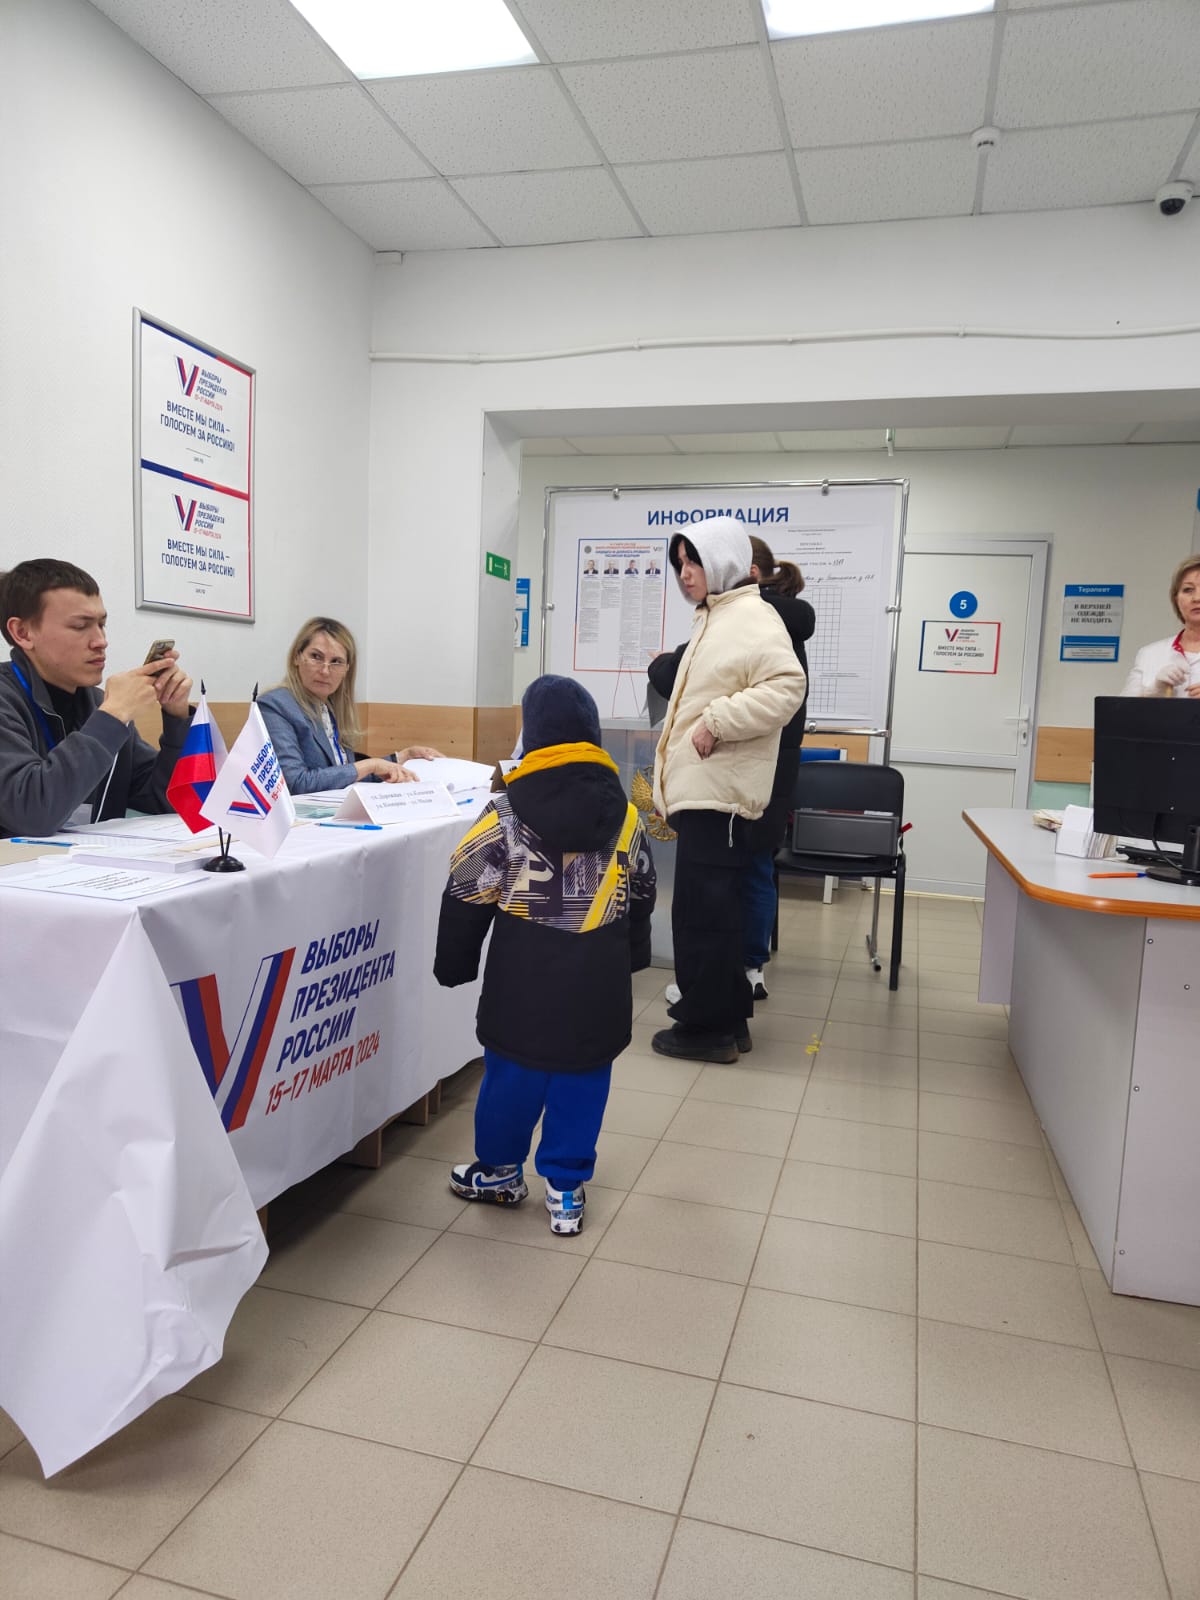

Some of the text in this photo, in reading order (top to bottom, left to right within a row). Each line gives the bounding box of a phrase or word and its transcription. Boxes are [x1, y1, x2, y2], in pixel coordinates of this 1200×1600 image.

[199, 378, 228, 396] ПРЕЗИДЕНТА
[201, 369, 222, 384] ВЫБОРЫ
[196, 386, 216, 398] РОССИИ
[166, 400, 194, 422] ВМЕСТЕ
[195, 412, 207, 426] МЫ
[208, 417, 225, 434] СИЛА
[160, 414, 235, 452] ГОЛОСУЕМ ЗА РОССИЮ!
[197, 510, 224, 524] ПРЕЗИДЕНТА
[199, 502, 219, 513] ВЫБОРЫ
[194, 519, 214, 530] РОССИИ
[167, 538, 194, 554] ВМЕСТЕ
[196, 544, 206, 556] МЫ
[208, 548, 224, 561] СИЛА
[162, 553, 236, 578] ГОЛОСУЕМ ЗА РОССИЮ!
[960, 600, 967, 610] 5
[301, 919, 380, 975] ВЫБОРЫ
[290, 950, 396, 1023] ПРЕЗИДЕНТА
[276, 1006, 356, 1073] РОССИИ
[308, 1042, 354, 1093] МАРТА
[354, 1030, 380, 1069] 2024
